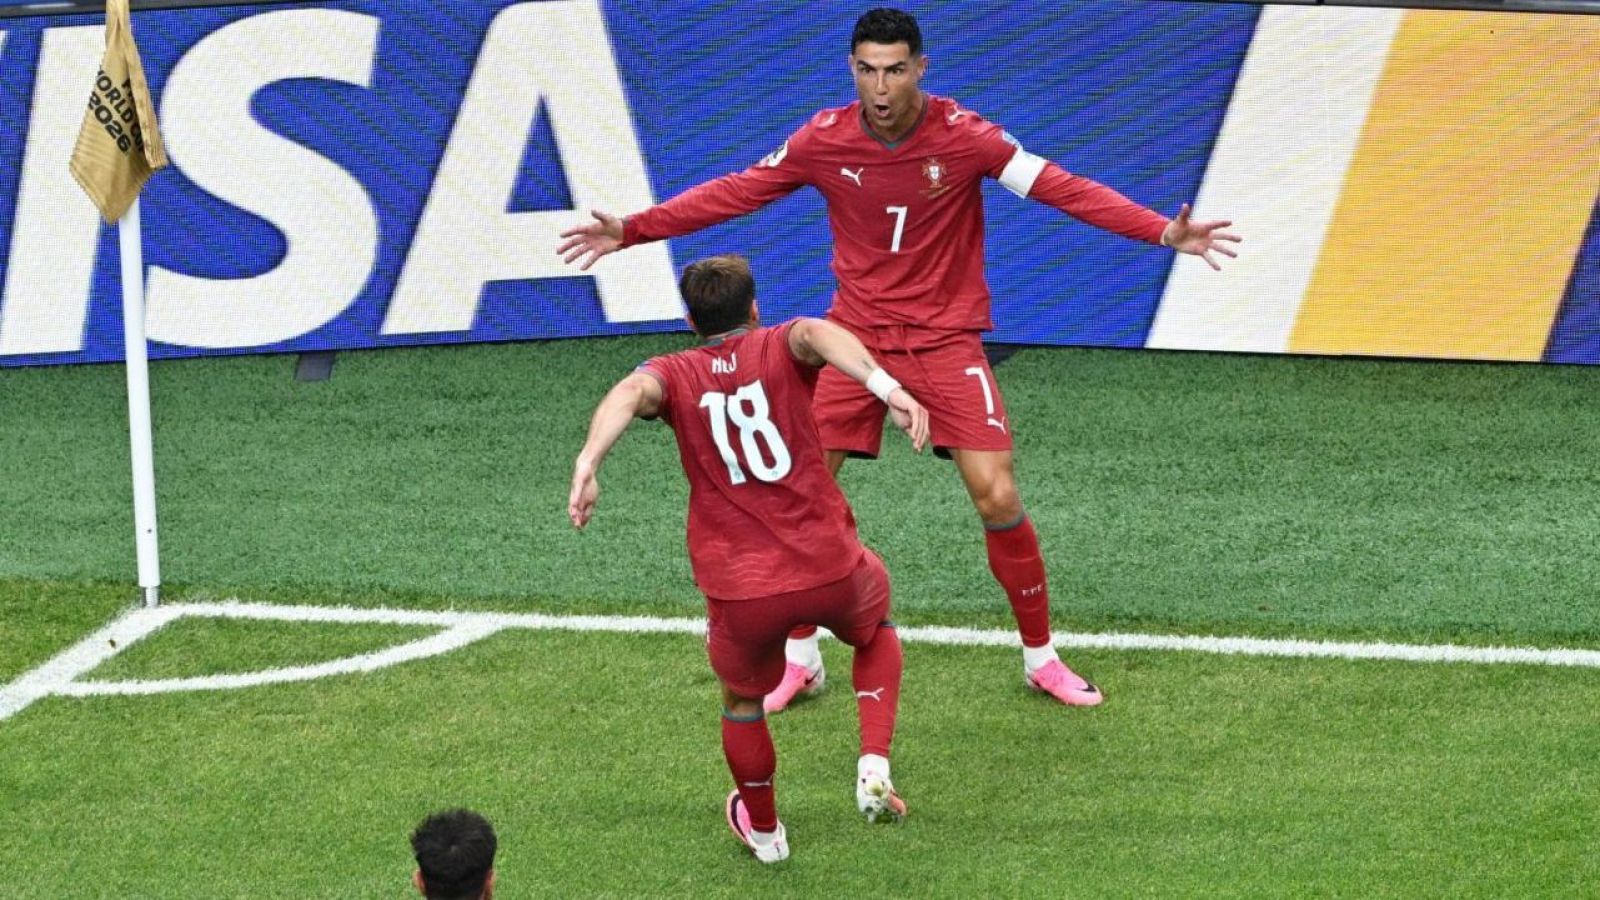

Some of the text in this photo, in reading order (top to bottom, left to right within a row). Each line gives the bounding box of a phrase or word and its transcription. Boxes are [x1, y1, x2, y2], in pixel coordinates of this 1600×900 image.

[88, 91, 132, 152] 2026
[0, 0, 684, 355] ISA
[886, 205, 908, 253] 7
[965, 367, 994, 415] 7
[699, 379, 792, 485] 18
